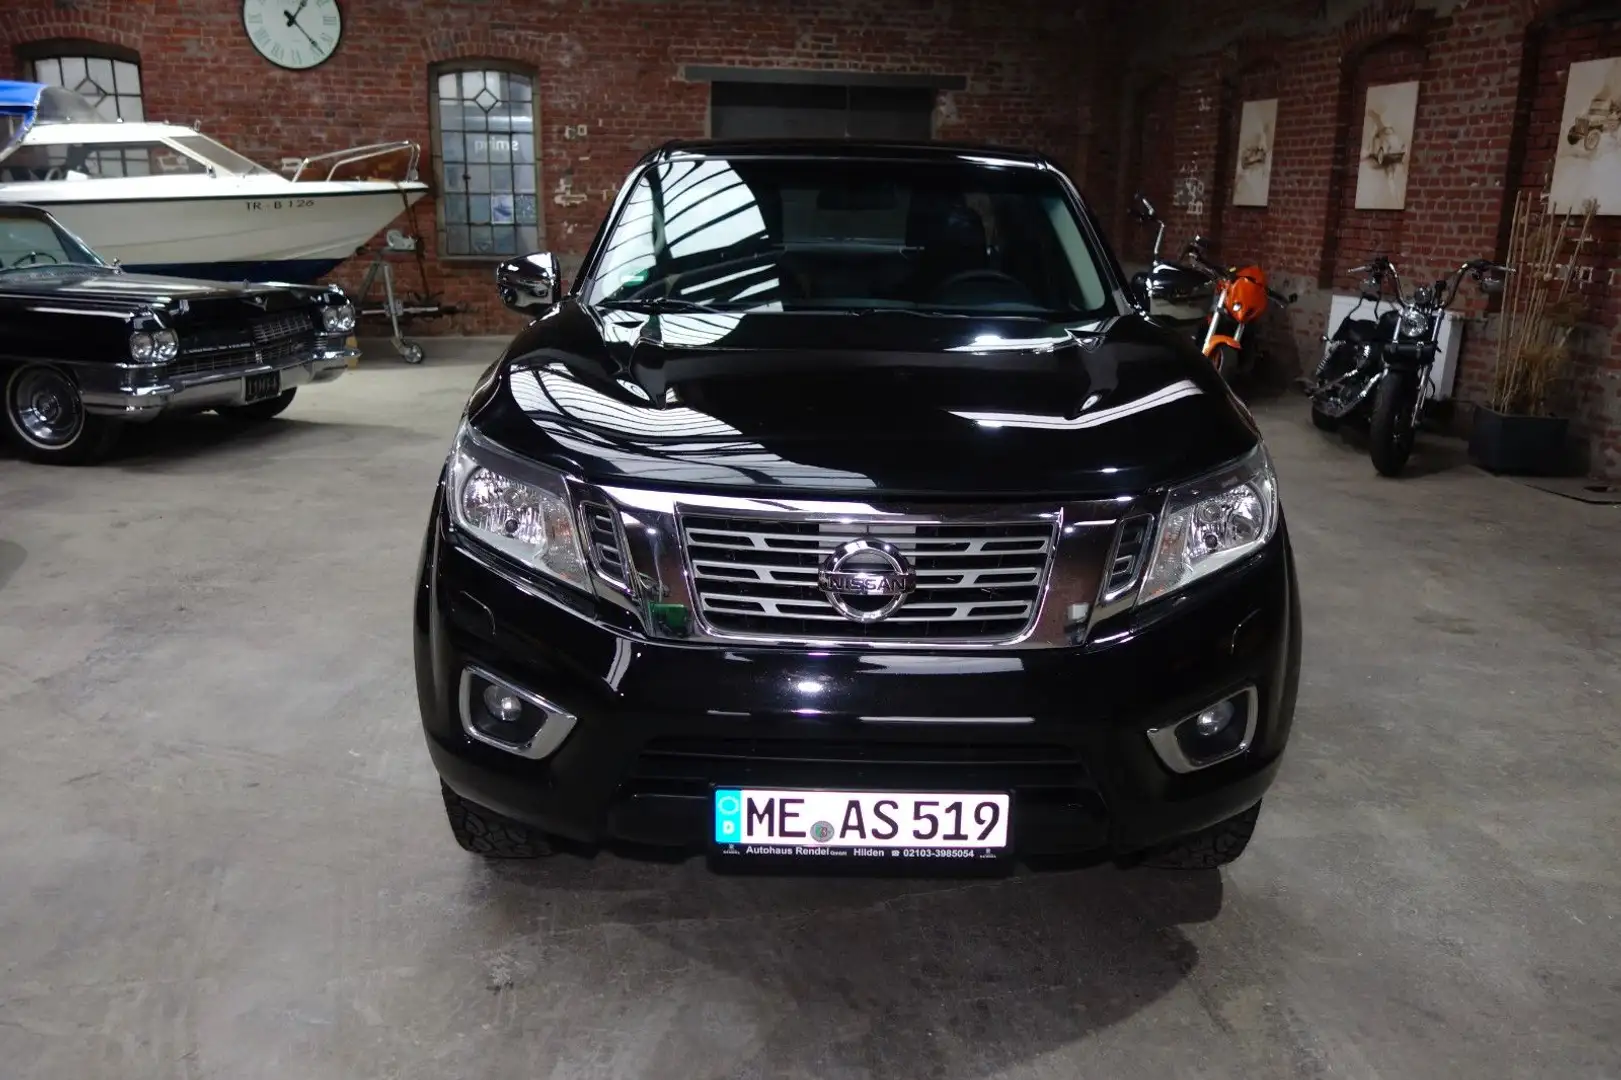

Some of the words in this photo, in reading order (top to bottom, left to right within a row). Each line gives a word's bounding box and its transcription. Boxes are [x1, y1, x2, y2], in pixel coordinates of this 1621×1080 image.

[827, 576, 907, 592] NISSAN
[746, 797, 807, 838] ME
[839, 799, 899, 840] AS
[912, 800, 1000, 842] 519
[745, 845, 793, 856] Autohaus
[795, 846, 830, 857] Rendel
[853, 848, 885, 858] Hilden
[903, 849, 975, 859] 02103-3985054
